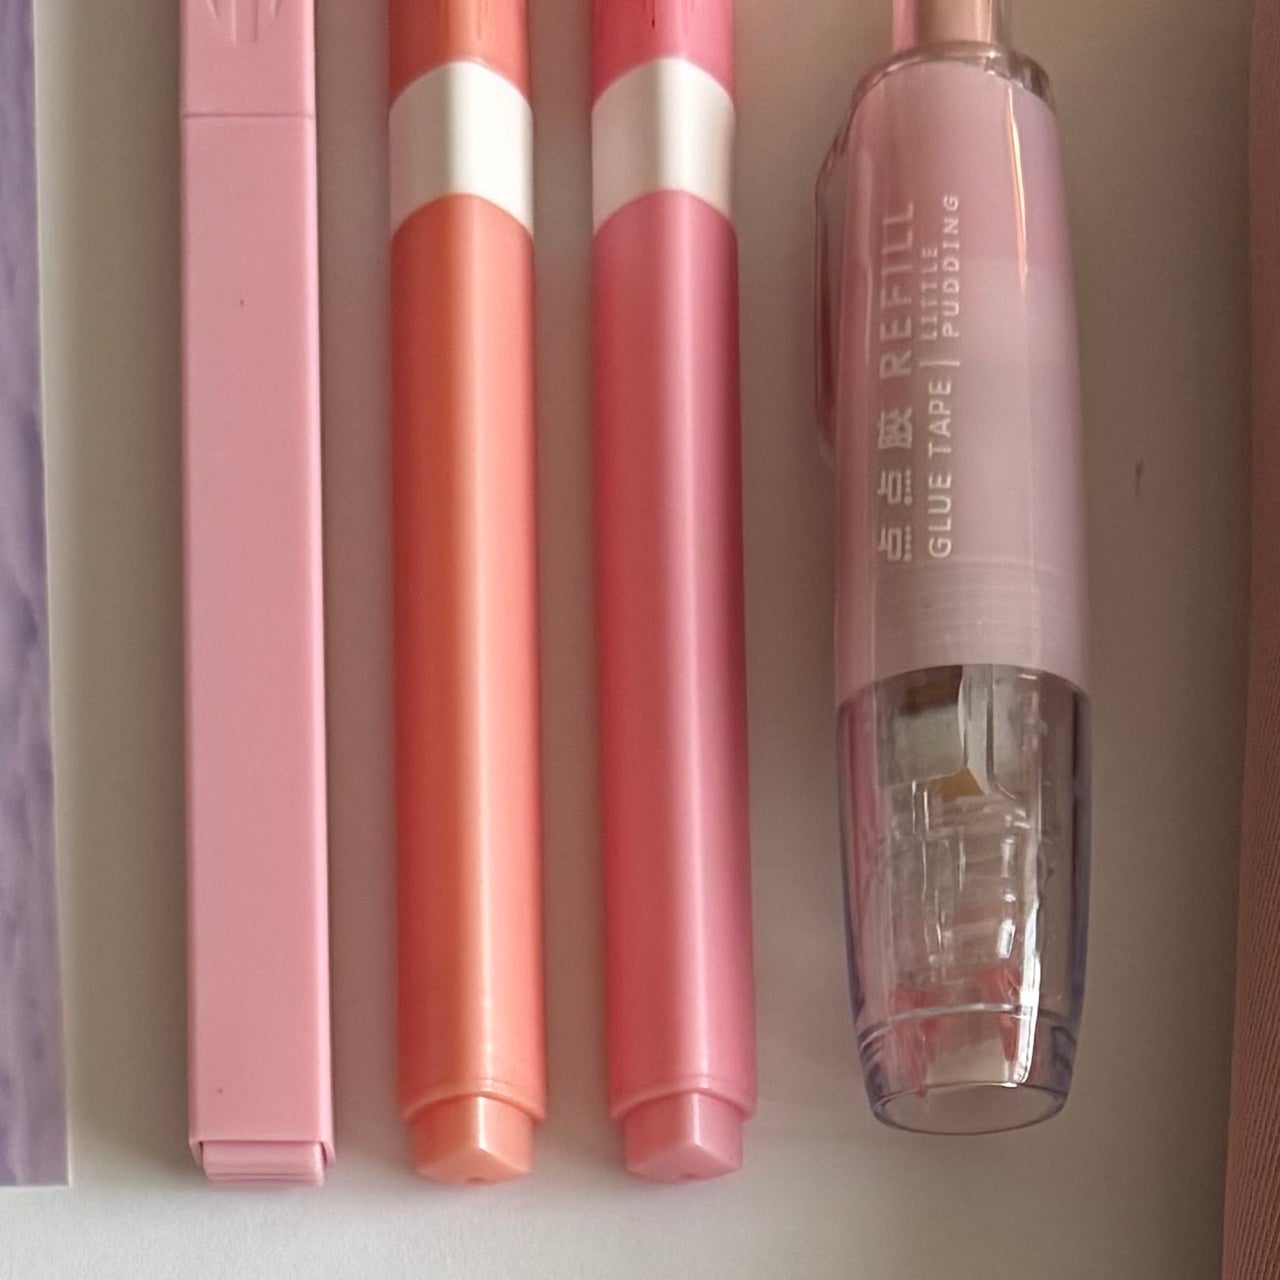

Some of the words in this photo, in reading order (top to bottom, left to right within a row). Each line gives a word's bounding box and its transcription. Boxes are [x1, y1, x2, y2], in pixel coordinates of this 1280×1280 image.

[879, 200, 914, 379] REFILL
[920, 246, 938, 341] LITTLE
[941, 193, 960, 338] PUDDING
[927, 380, 952, 459] TAPE
[927, 472, 952, 558] GLUE
